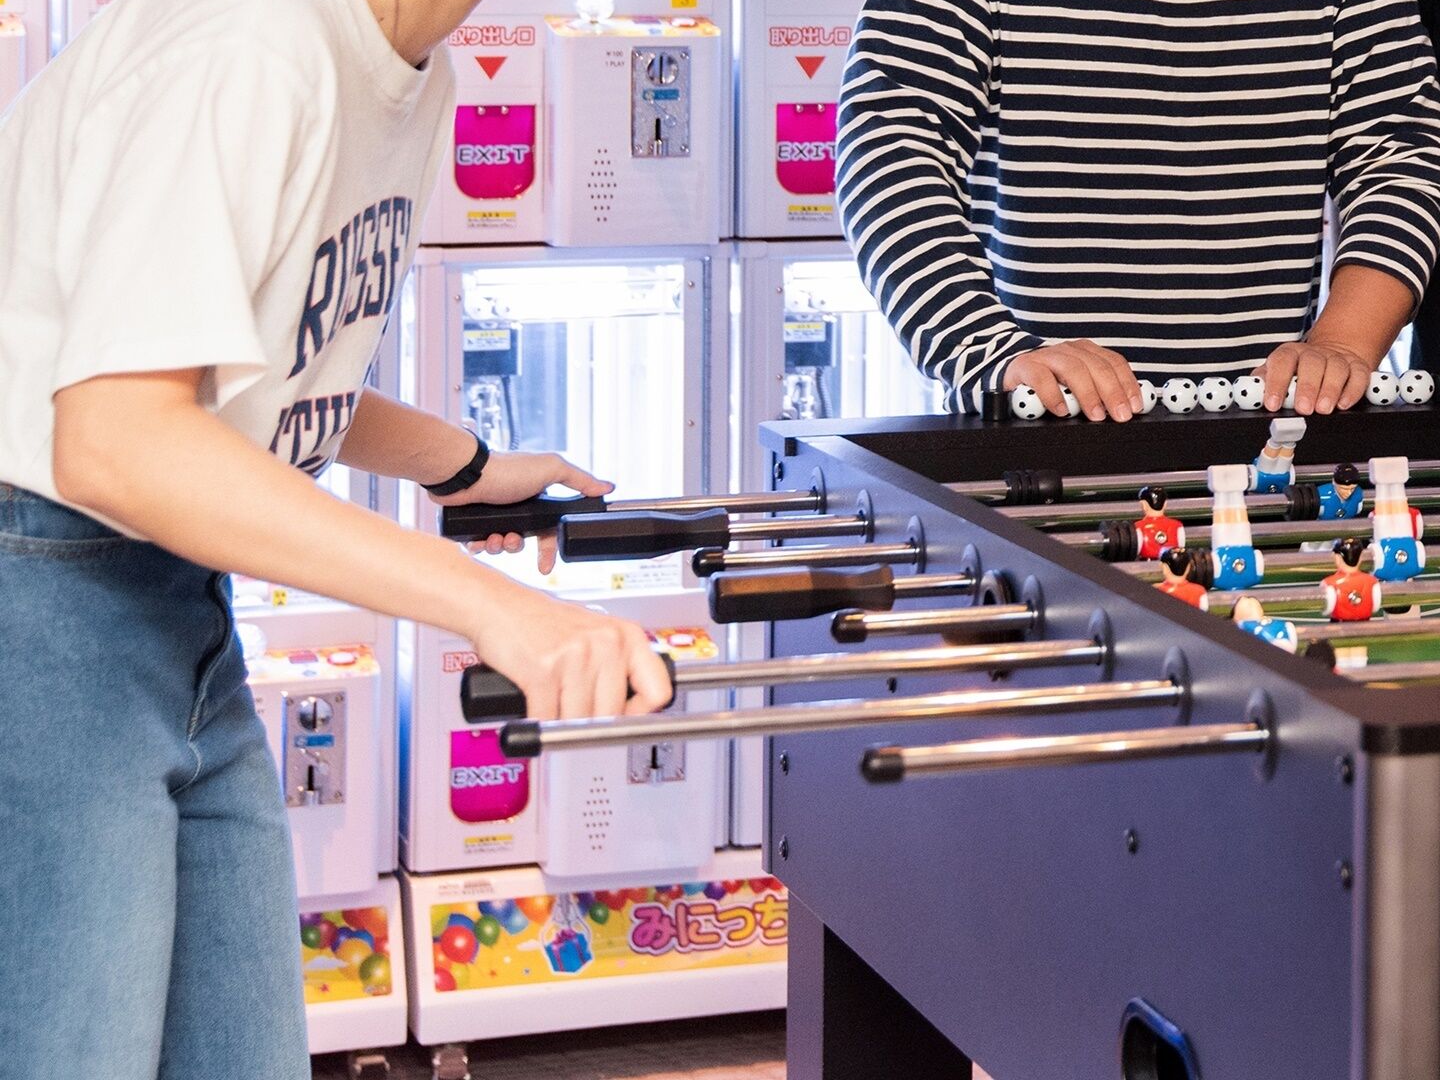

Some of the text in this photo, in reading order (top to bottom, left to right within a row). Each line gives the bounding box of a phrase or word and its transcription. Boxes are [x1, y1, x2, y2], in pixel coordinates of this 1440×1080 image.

[769, 26, 852, 47] 取り出し口
[457, 144, 530, 165] EXIT
[451, 763, 525, 789] EXIT
